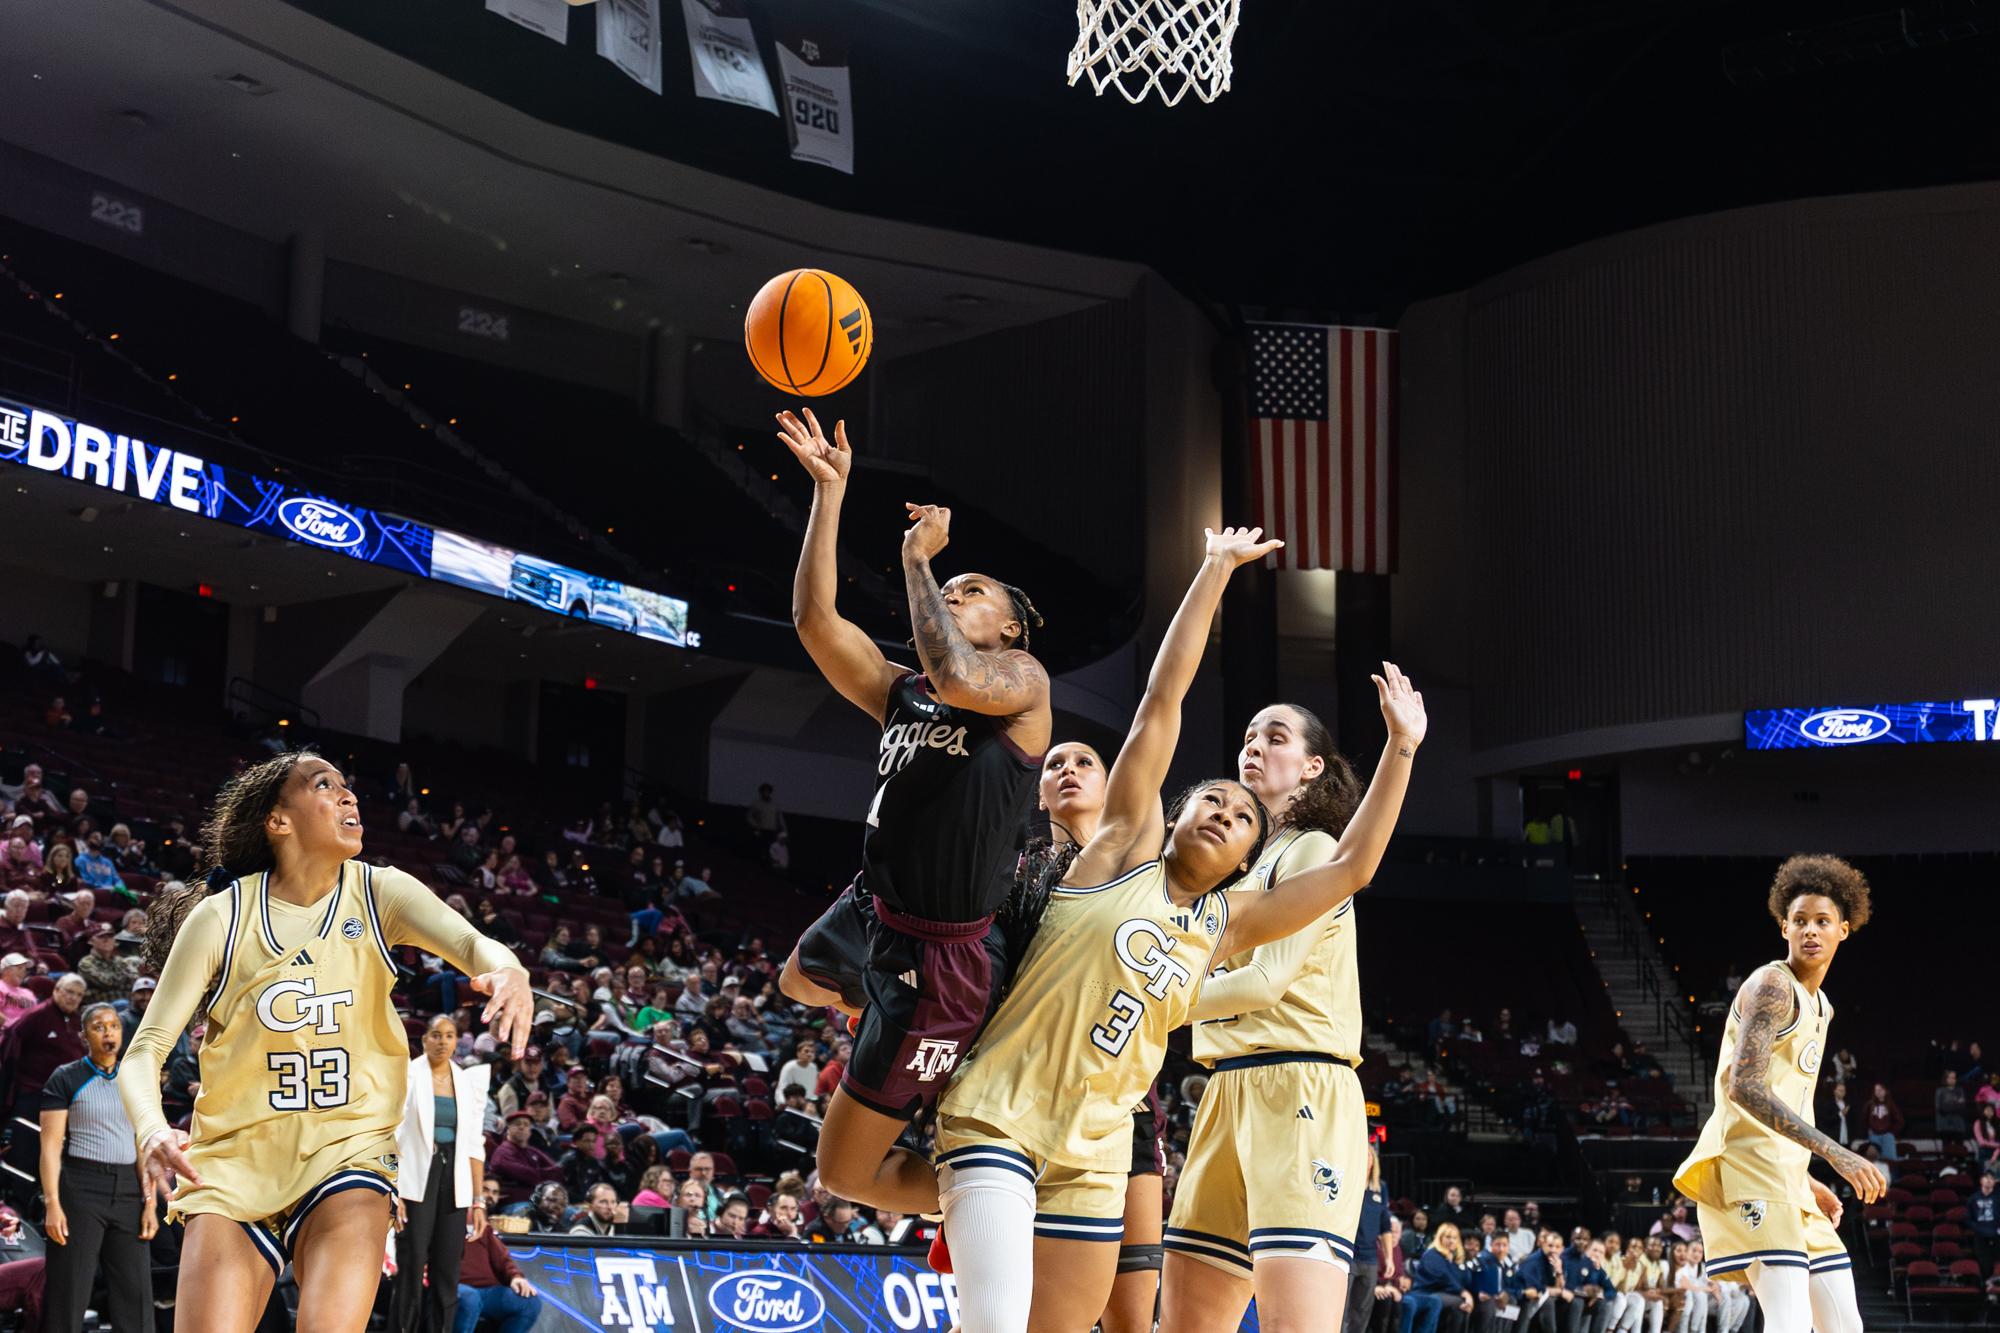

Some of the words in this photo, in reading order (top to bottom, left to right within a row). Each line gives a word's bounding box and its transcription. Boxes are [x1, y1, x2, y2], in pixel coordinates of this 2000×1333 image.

[91, 194, 143, 232] 223
[458, 308, 508, 340] 224
[27, 409, 204, 513] DRIVE
[294, 502, 349, 543] Ford
[879, 708, 969, 776] ggies
[1818, 714, 1874, 738] Ford
[1963, 699, 2000, 741] T
[1114, 918, 1190, 1001] GT
[255, 976, 353, 1035] GT
[1090, 989, 1145, 1058] 3
[267, 1047, 350, 1111] 33
[732, 1277, 804, 1323] Ford
